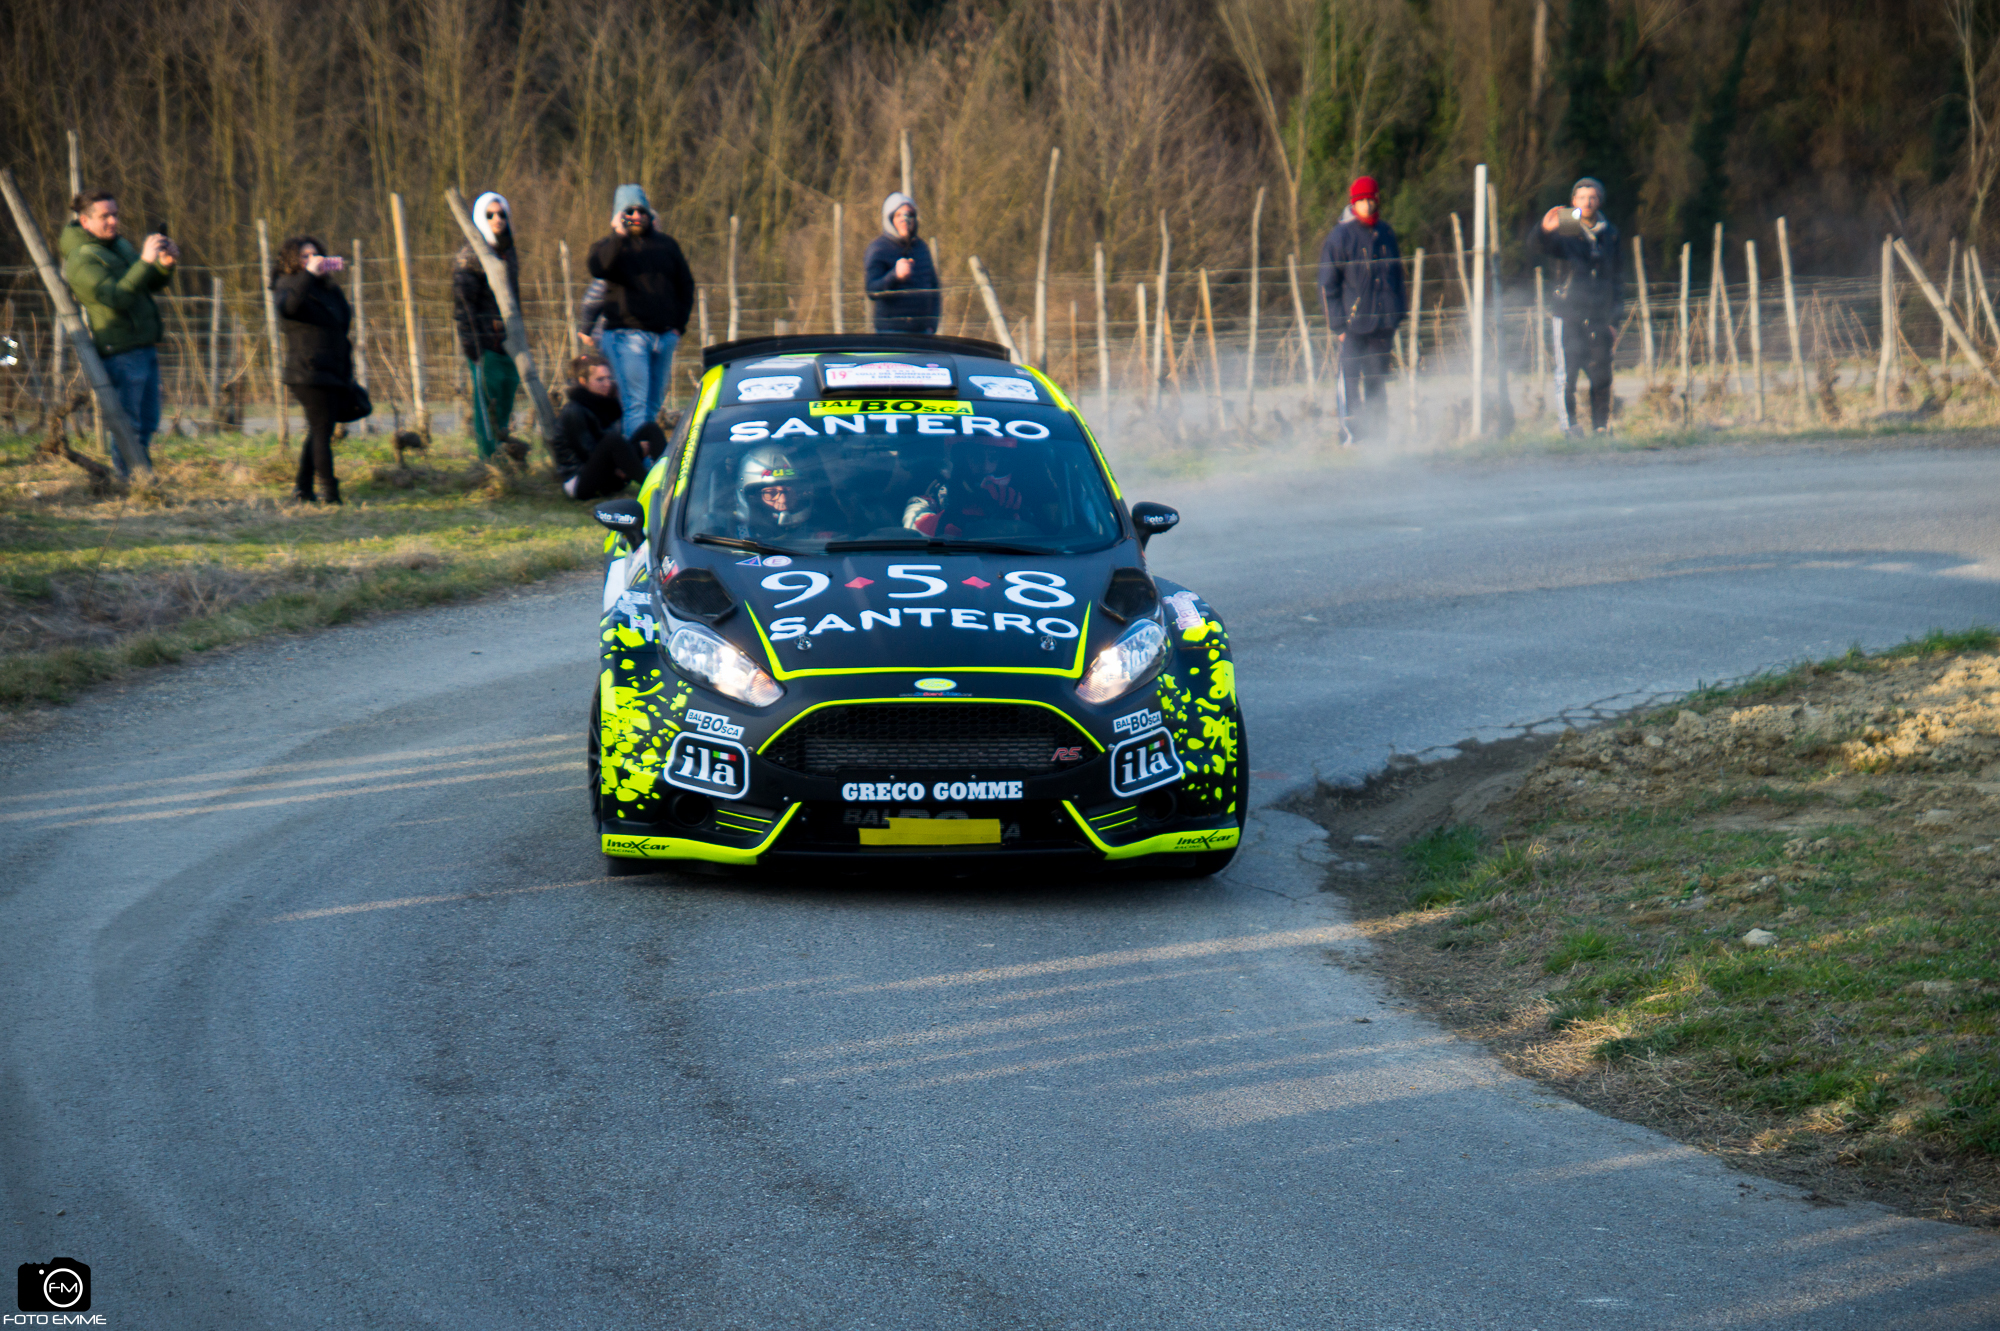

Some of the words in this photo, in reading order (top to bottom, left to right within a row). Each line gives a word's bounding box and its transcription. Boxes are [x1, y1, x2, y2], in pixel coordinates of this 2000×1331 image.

[729, 414, 1050, 442] SANTERO
[760, 570, 830, 608] 9
[887, 564, 948, 598] 5
[1004, 570, 1076, 608] 8
[769, 607, 1080, 640] SANTERO
[688, 711, 739, 737] BALBOSCA
[1116, 712, 1161, 731] BALBOSCA
[675, 745, 737, 787] ila
[1051, 747, 1081, 761] RS
[1122, 746, 1172, 785] ila
[842, 782, 925, 801] GRECO
[933, 781, 1023, 801] GOMME
